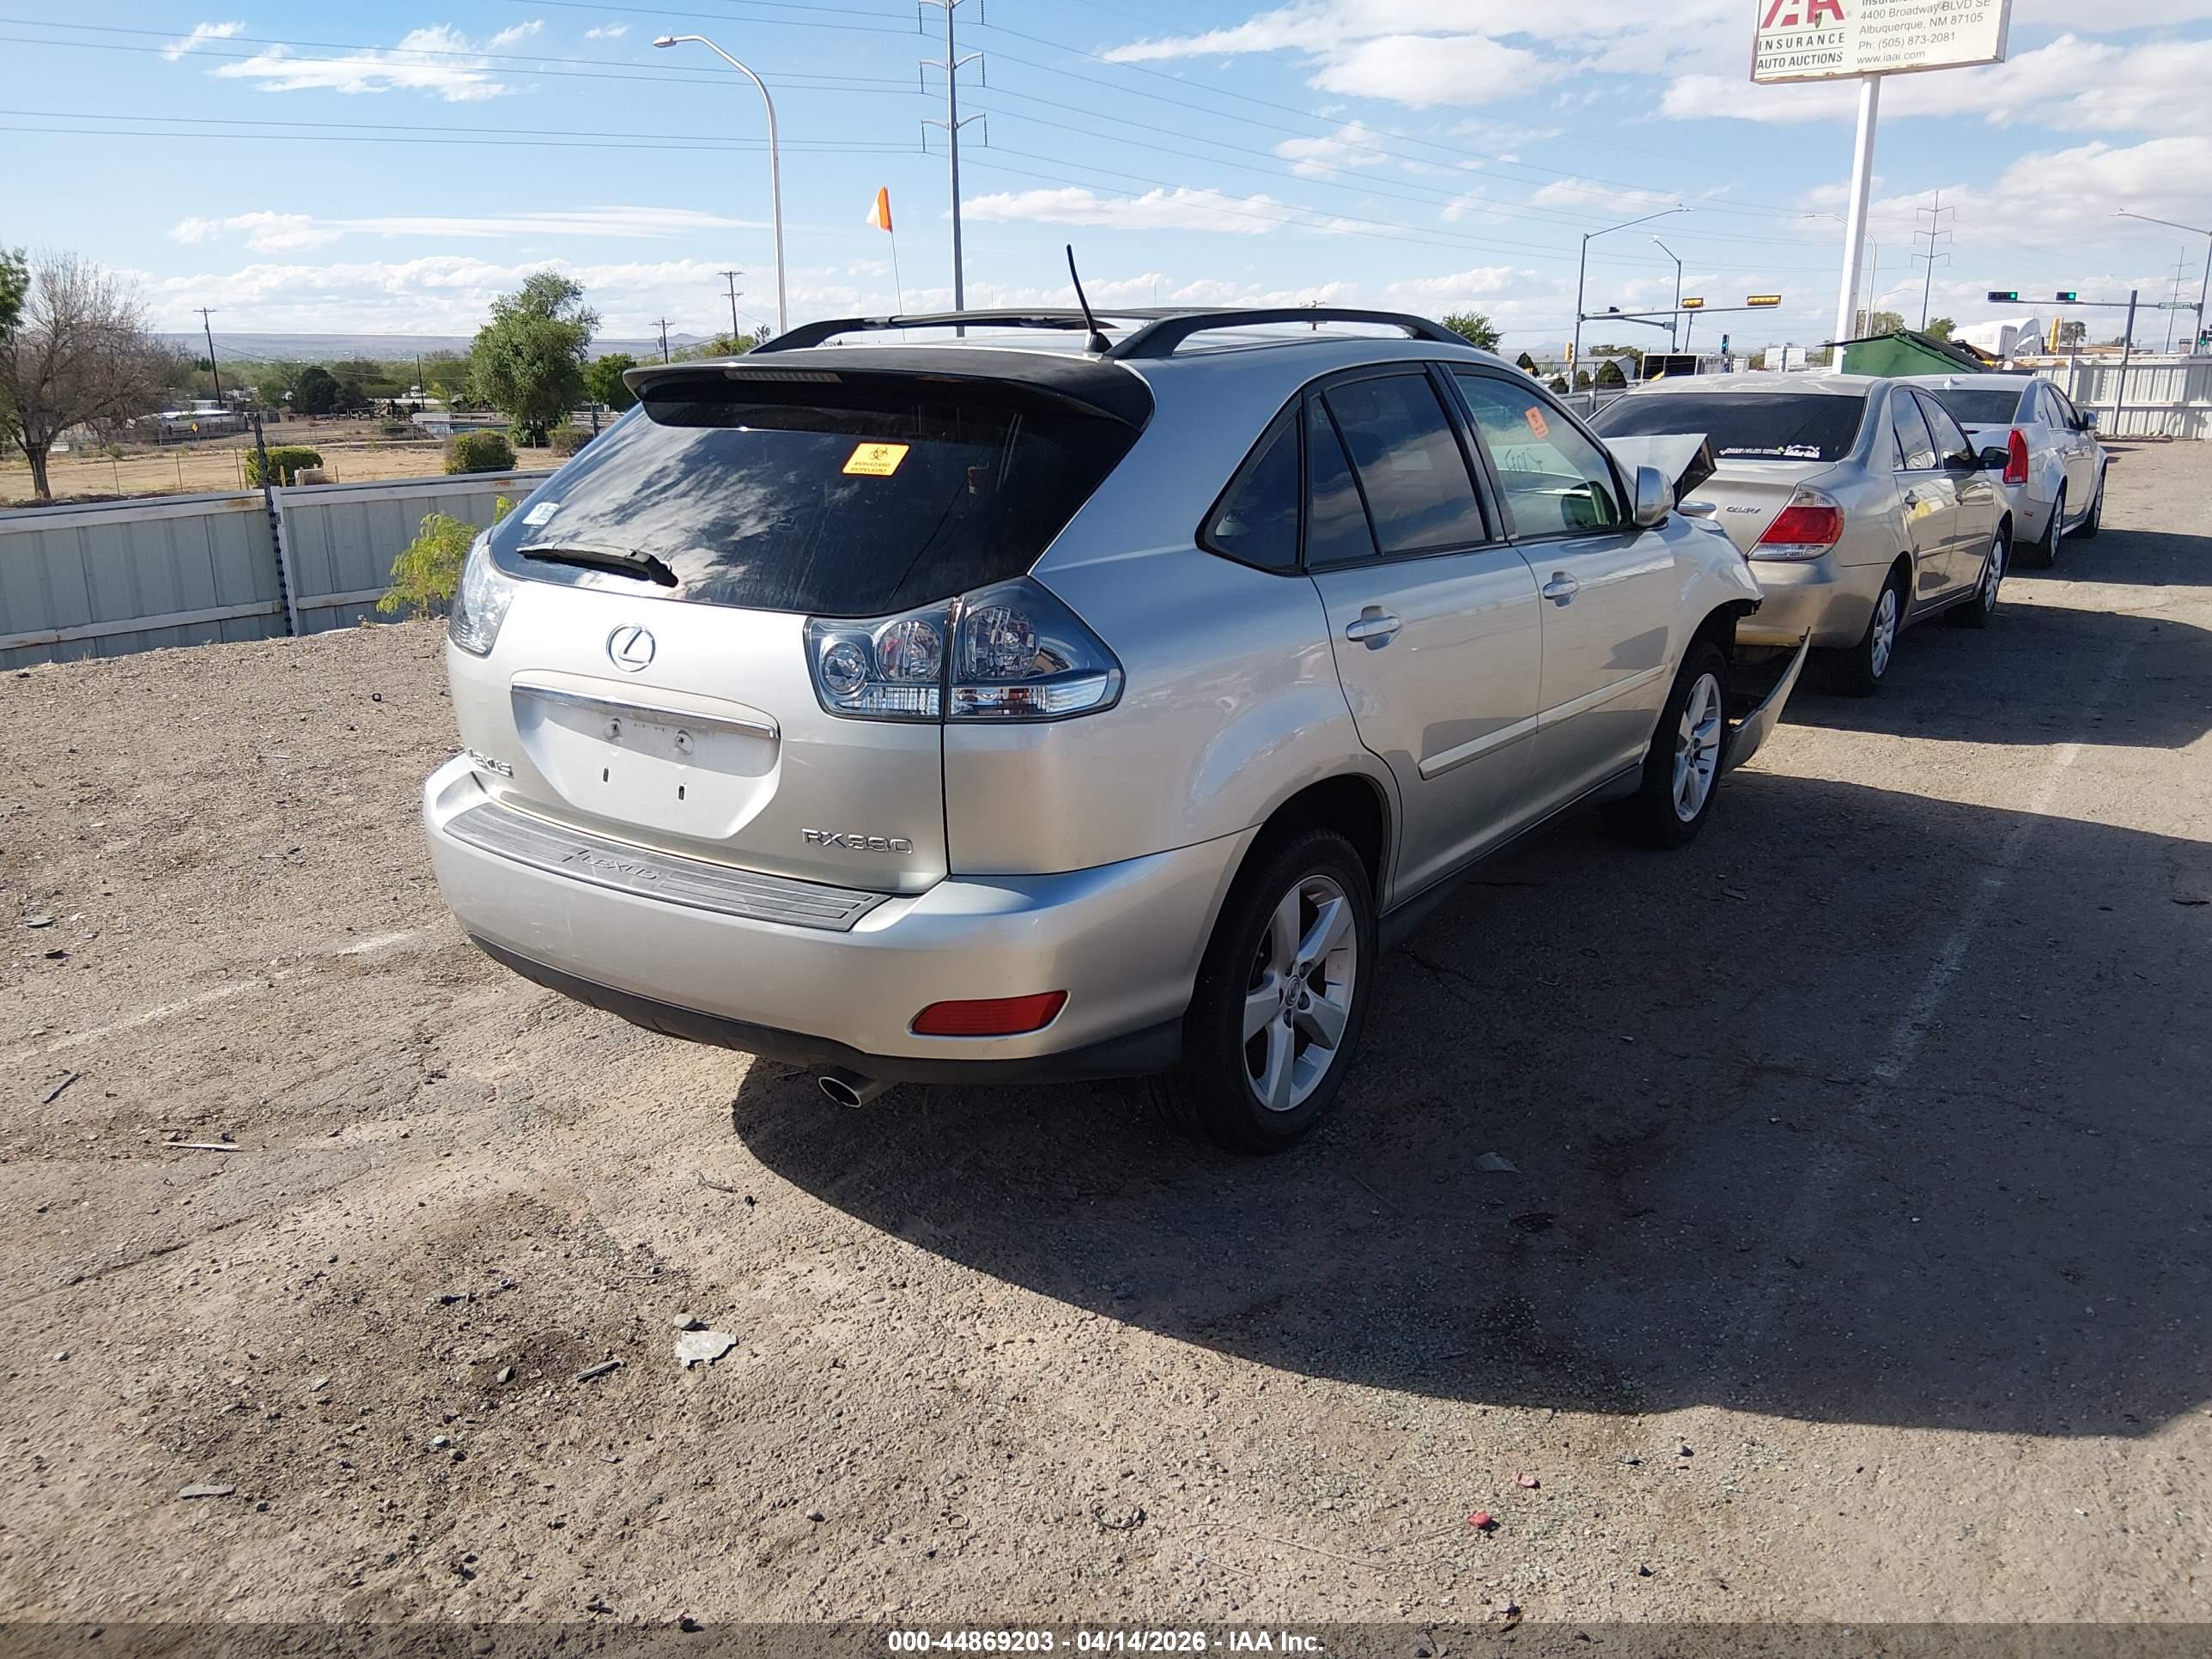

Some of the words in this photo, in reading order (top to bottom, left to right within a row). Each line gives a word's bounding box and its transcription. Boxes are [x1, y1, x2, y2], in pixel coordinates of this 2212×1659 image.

[1861, 9, 1886, 20] 4400
[1889, 3, 1939, 17] Broadway
[1942, 0, 1972, 11] BLVD
[1859, 20, 1926, 35] Albuquerque,
[1929, 16, 1948, 27] NM
[1950, 12, 1984, 25] 87105
[1759, 33, 1844, 52] INSURANCE
[1878, 37, 1905, 50] (505)
[1907, 31, 1955, 46] 873-2081
[1757, 57, 1786, 70] AUTO
[1789, 52, 1844, 67] AUCTIONS
[1856, 51, 1925, 64] www.iaai.com
